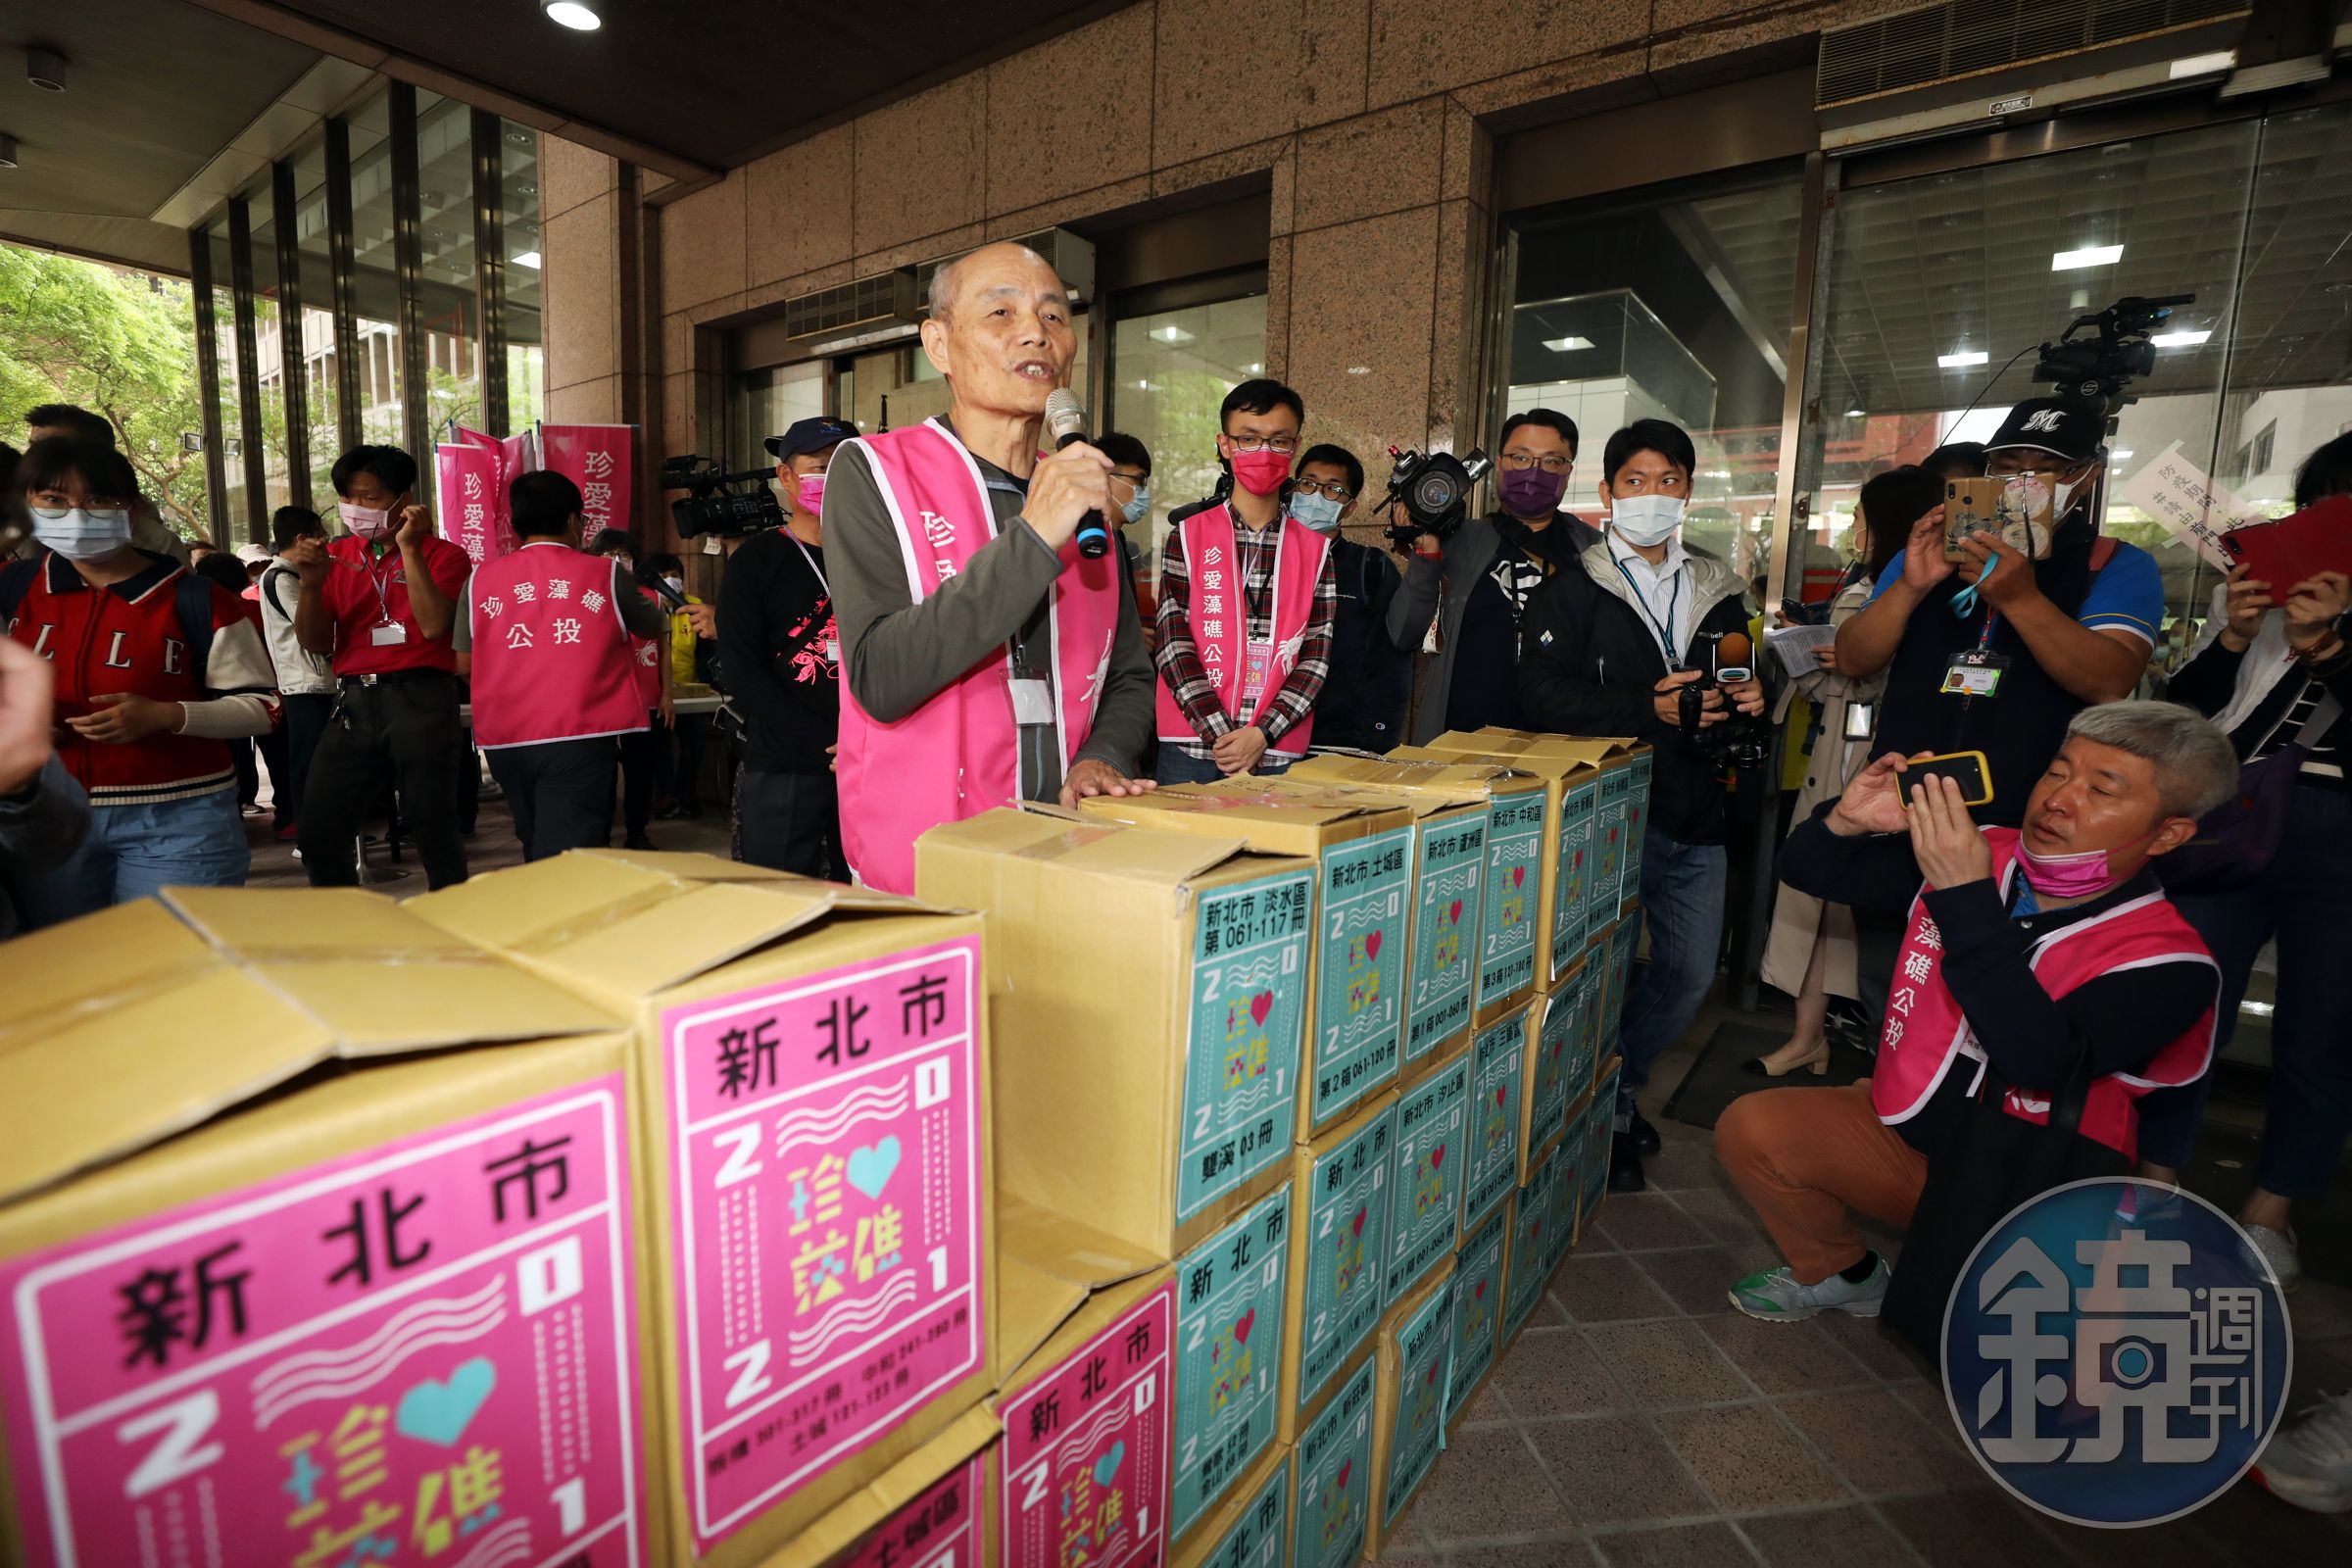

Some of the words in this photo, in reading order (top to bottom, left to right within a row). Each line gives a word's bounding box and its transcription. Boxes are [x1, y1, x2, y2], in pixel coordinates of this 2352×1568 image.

[461, 472, 485, 574] 珍愛藻
[479, 579, 607, 618] 珍愛藻礁
[1203, 546, 1224, 688] 珍愛藻礁公投
[506, 617, 582, 650] 公投
[1494, 809, 1515, 828] 新北市
[1332, 859, 1368, 890] 新北市
[1372, 848, 1403, 877] 土城區
[1428, 837, 1456, 860] 新北市
[1204, 894, 1255, 929] 新北市
[1263, 882, 1307, 914] 淡水區
[1226, 912, 1287, 949] 061-117
[1886, 915, 1942, 1051] 藻礁公投
[715, 975, 948, 1100] 新北市
[1352, 1047, 1385, 1079] 061-120
[1404, 1094, 1434, 1127] 新北市
[1438, 1070, 1464, 1104] 汐止區
[1240, 1133, 1253, 1157] 03
[1327, 1124, 1387, 1192] 新北市
[113, 1134, 572, 1372] 新北市
[1190, 1207, 1284, 1304] 新北市
[1030, 1322, 1152, 1443] 新北市
[1214, 1489, 1278, 1568] 北市
